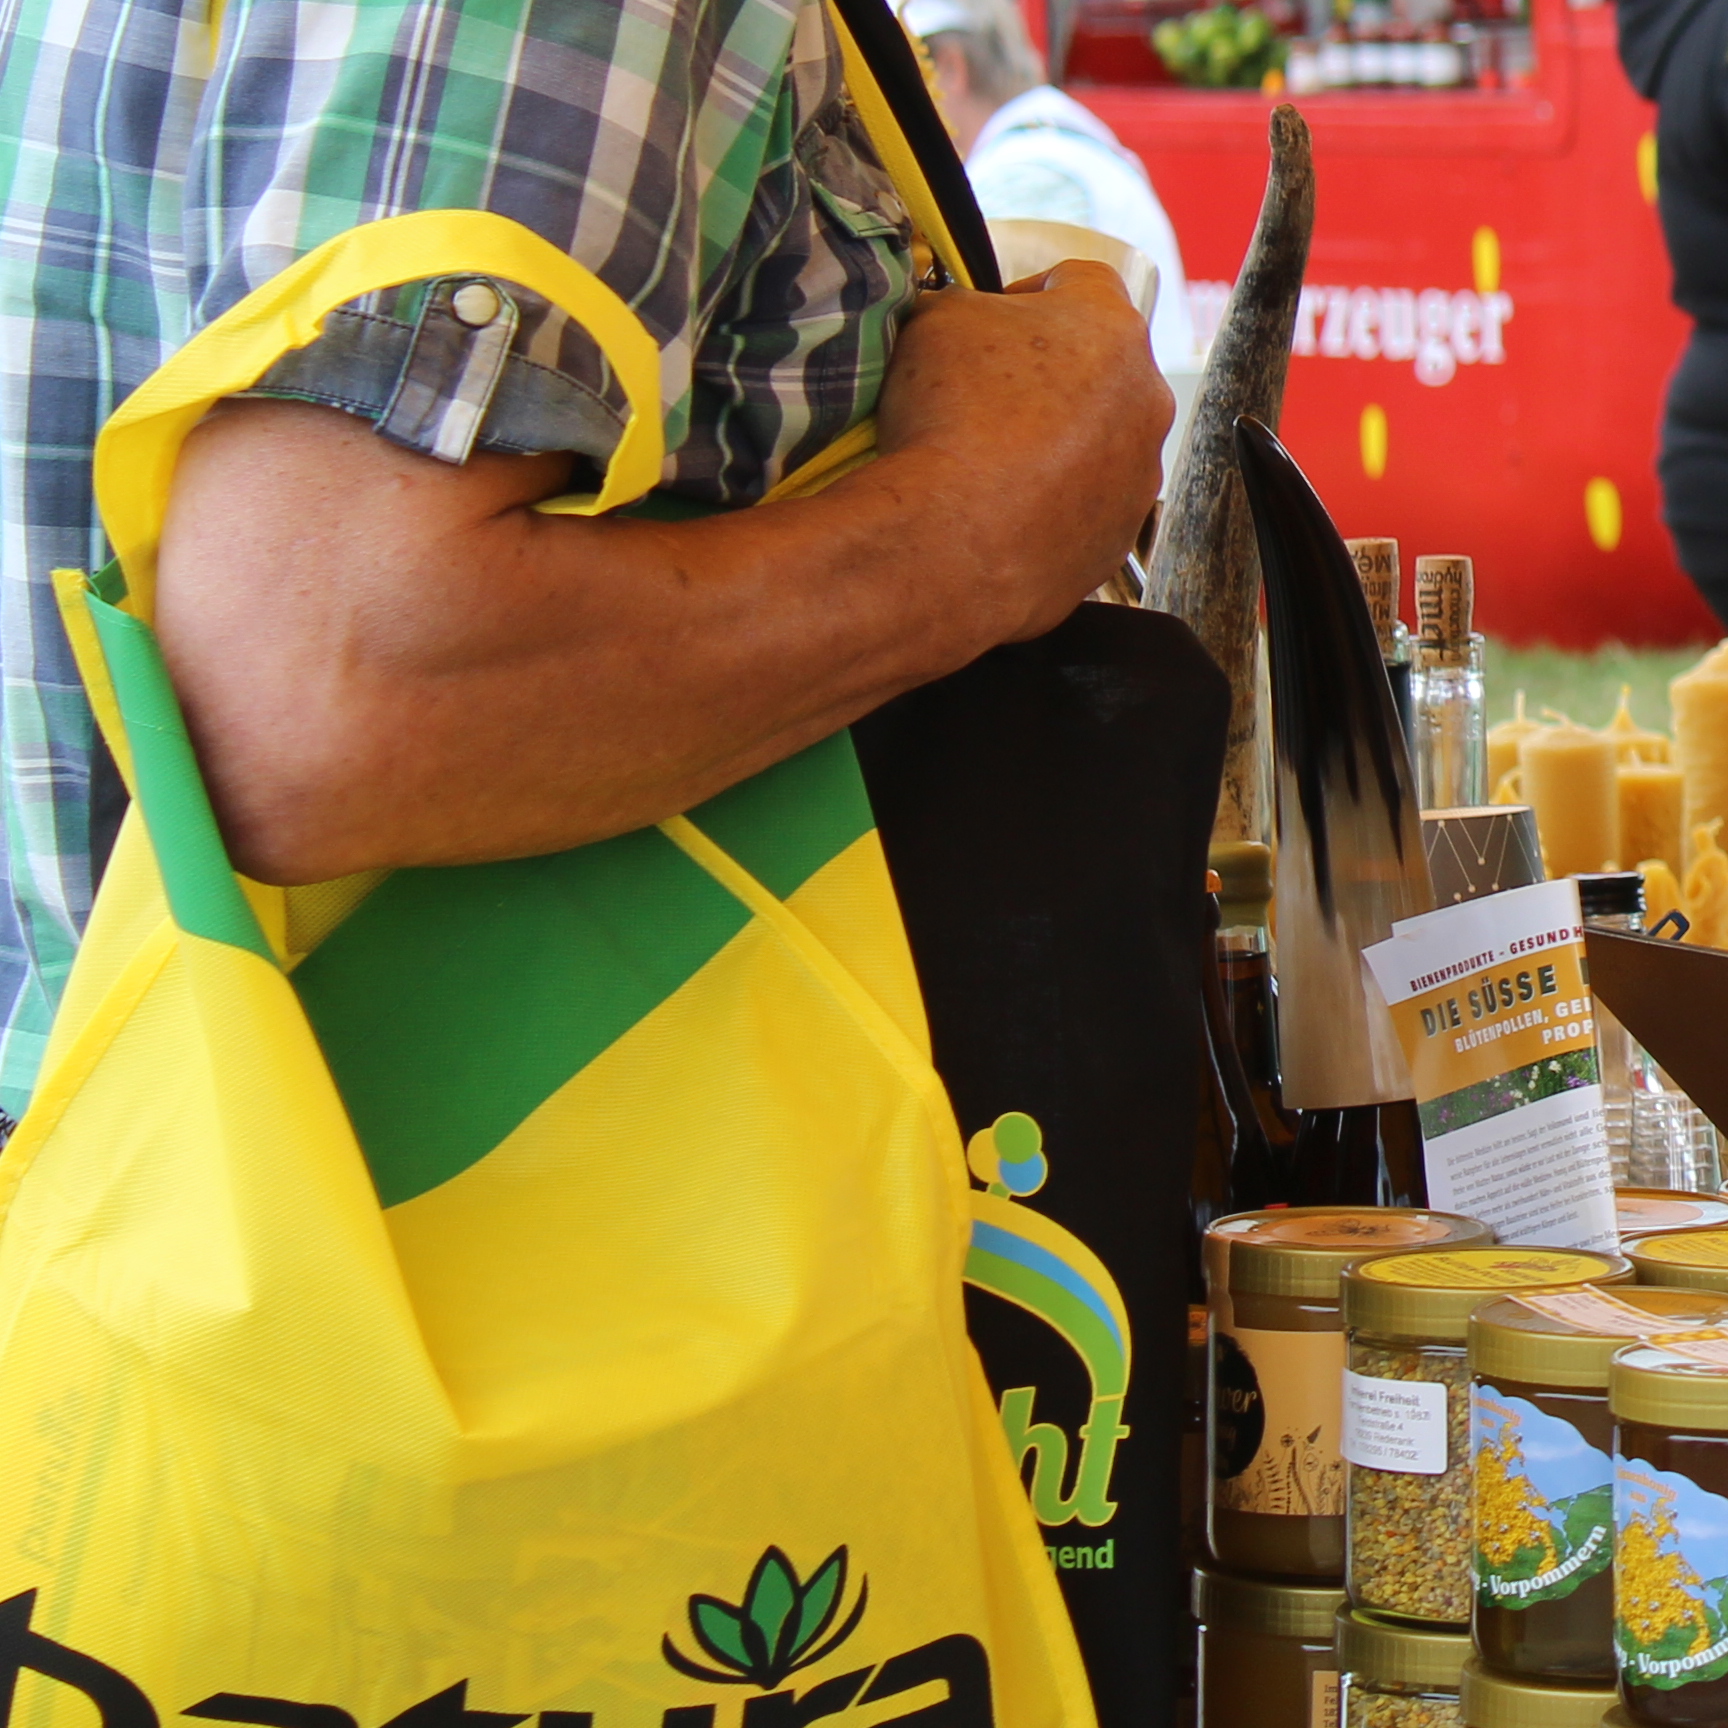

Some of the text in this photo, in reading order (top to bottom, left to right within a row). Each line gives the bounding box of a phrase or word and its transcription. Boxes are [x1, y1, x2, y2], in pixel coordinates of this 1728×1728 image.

[1291, 282, 1515, 387] rzeuger
[1409, 950, 1495, 992] BIENENPRODUKTE
[1510, 925, 1584, 954] GESUNDH
[1420, 964, 1559, 1038] DIE SÜSSE
[1454, 1008, 1550, 1053] BLÜTENPOLLEN,
[1489, 1524, 1608, 1599] Vorpommern
